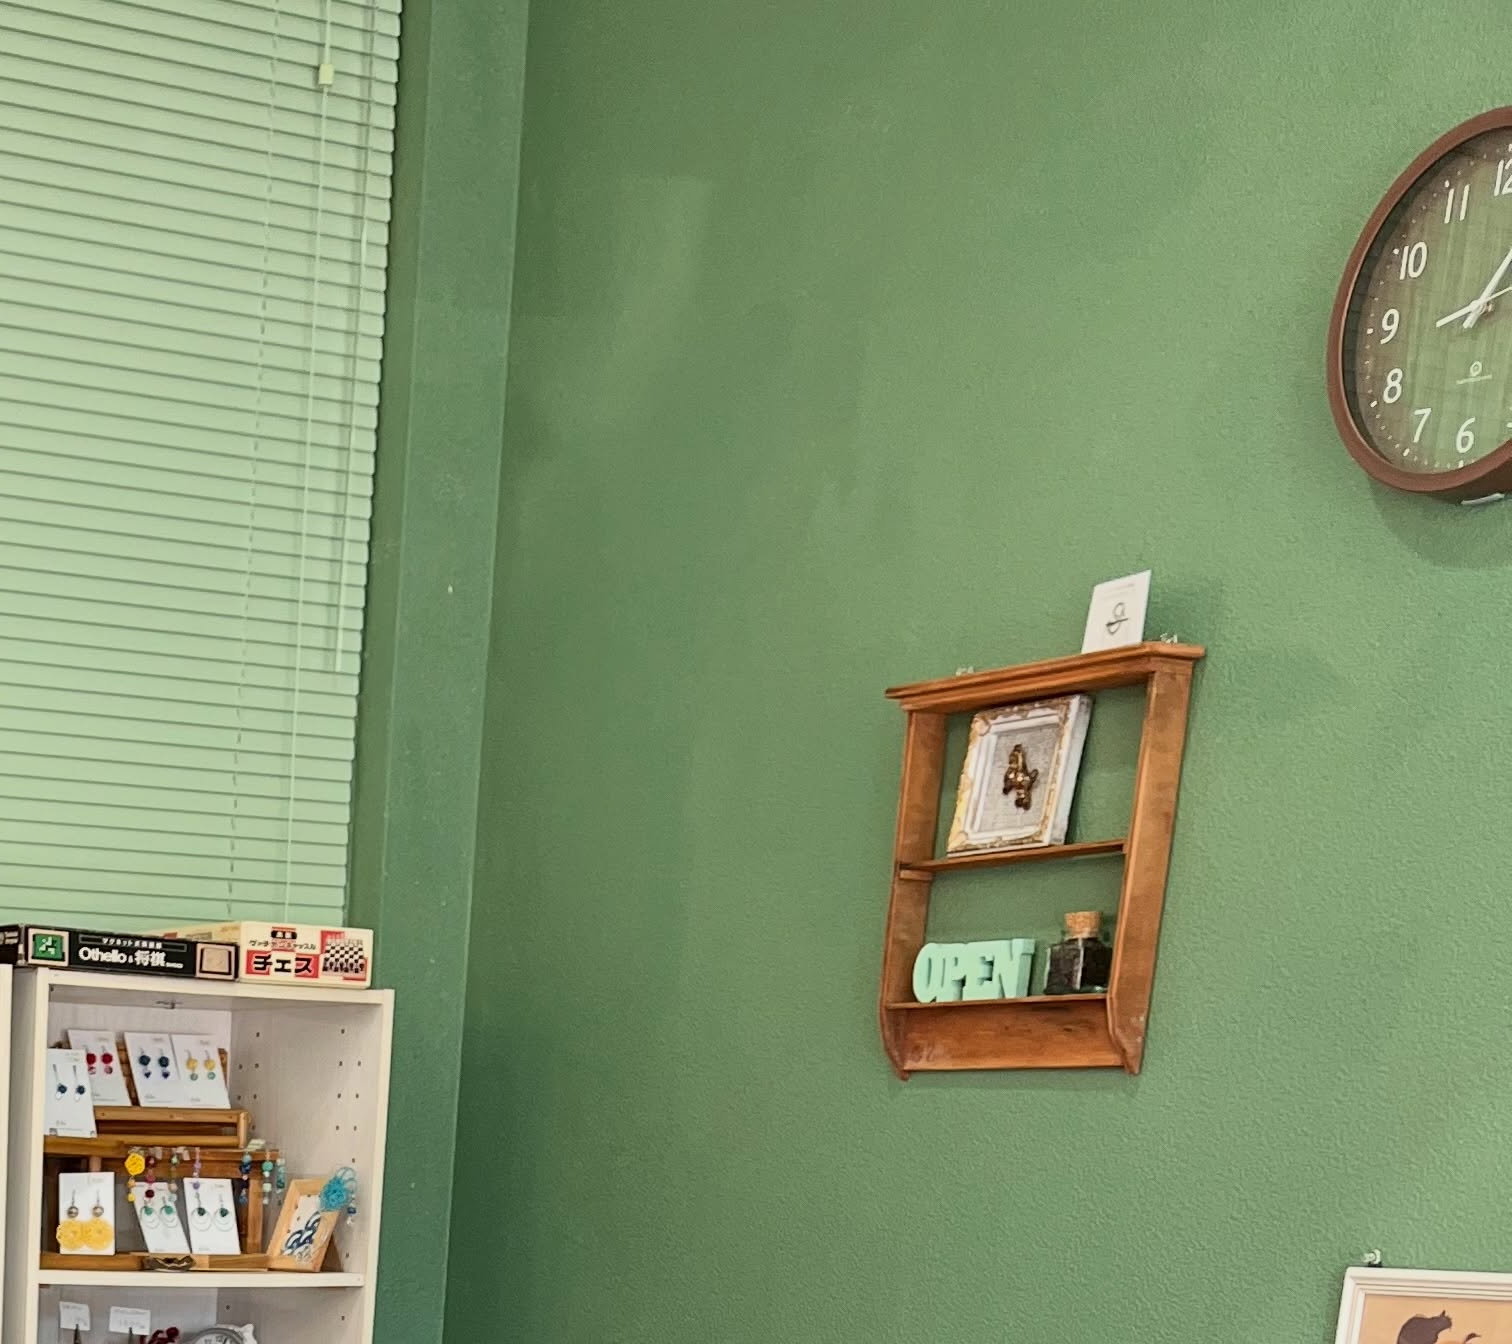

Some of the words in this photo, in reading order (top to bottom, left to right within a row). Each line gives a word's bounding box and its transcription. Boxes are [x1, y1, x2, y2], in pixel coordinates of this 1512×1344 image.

[1444, 184, 1471, 224] 11
[1399, 241, 1428, 280] 10
[1380, 308, 1400, 344] 9
[1383, 368, 1403, 404] 8
[1413, 407, 1432, 443] 7
[1456, 417, 1476, 454] 6
[78, 946, 128, 964] Othello
[134, 949, 166, 967] 将棋
[252, 954, 313, 974] チェス
[913, 938, 1035, 1004] OPEN
